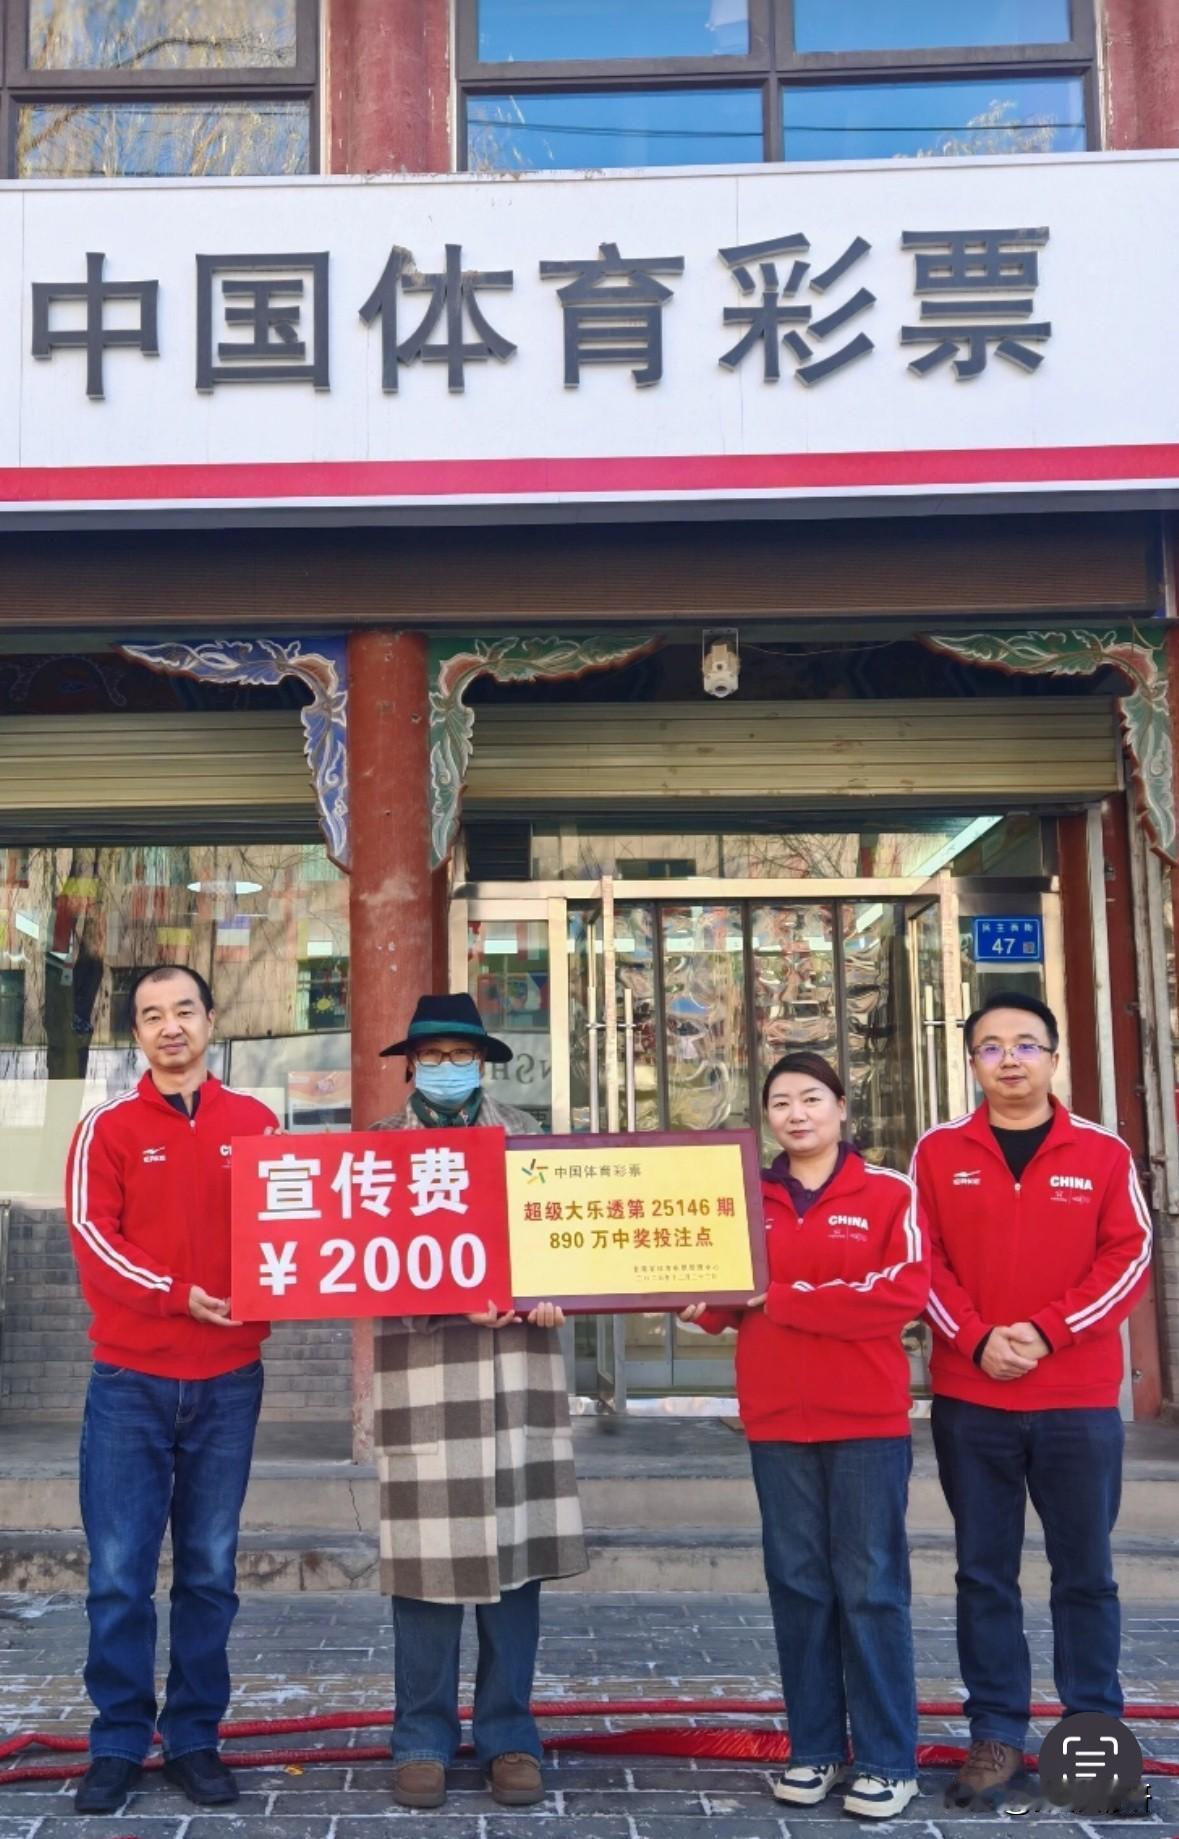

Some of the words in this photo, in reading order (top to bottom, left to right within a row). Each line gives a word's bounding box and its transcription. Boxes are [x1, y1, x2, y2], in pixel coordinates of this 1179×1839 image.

[31, 226, 1052, 401] 中国体育彩票
[992, 938, 1016, 954] 47
[554, 1163, 642, 1178] 中国体育彩票
[257, 1147, 469, 1221] 宣传费
[1050, 1175, 1093, 1191] CHINA
[828, 1215, 869, 1231] CHINA
